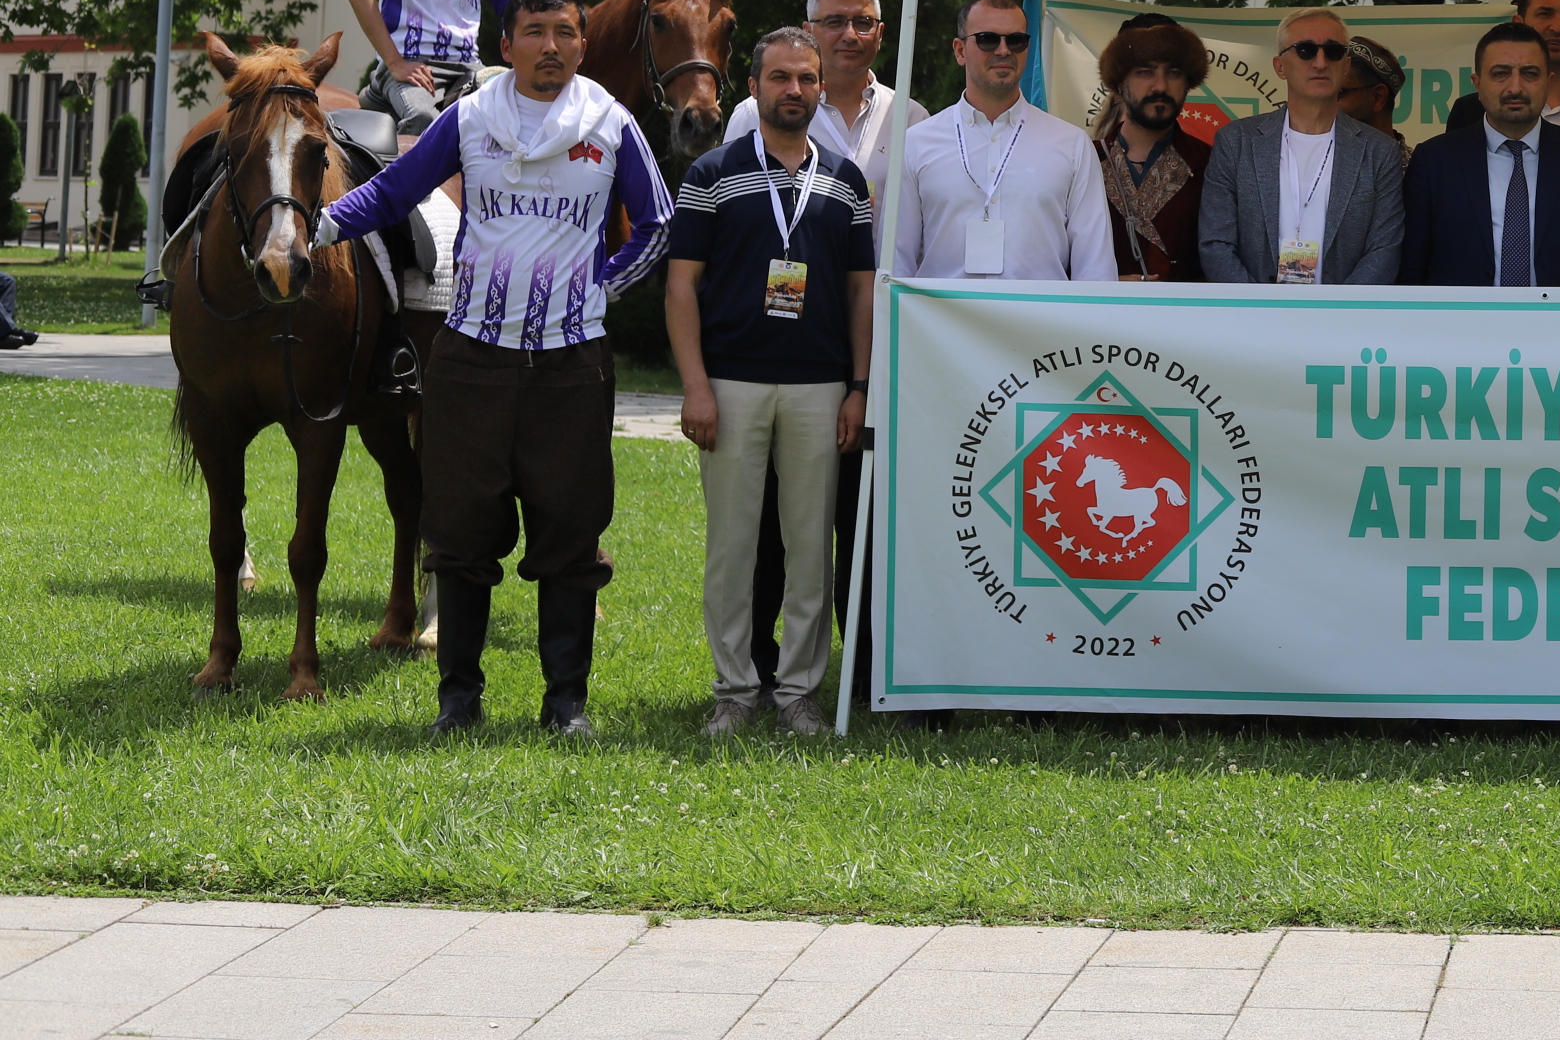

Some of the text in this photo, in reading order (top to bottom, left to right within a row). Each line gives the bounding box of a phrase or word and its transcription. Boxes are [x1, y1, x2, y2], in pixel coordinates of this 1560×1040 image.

[479, 184, 600, 234] AK KALPAK
[952, 343, 1262, 632] TÜRKİYE GELENEKSEL ATLI SPOR DALLARI FEDERASYONU
[1348, 466, 1501, 540] ATLI
[1071, 634, 1137, 658] 2022
